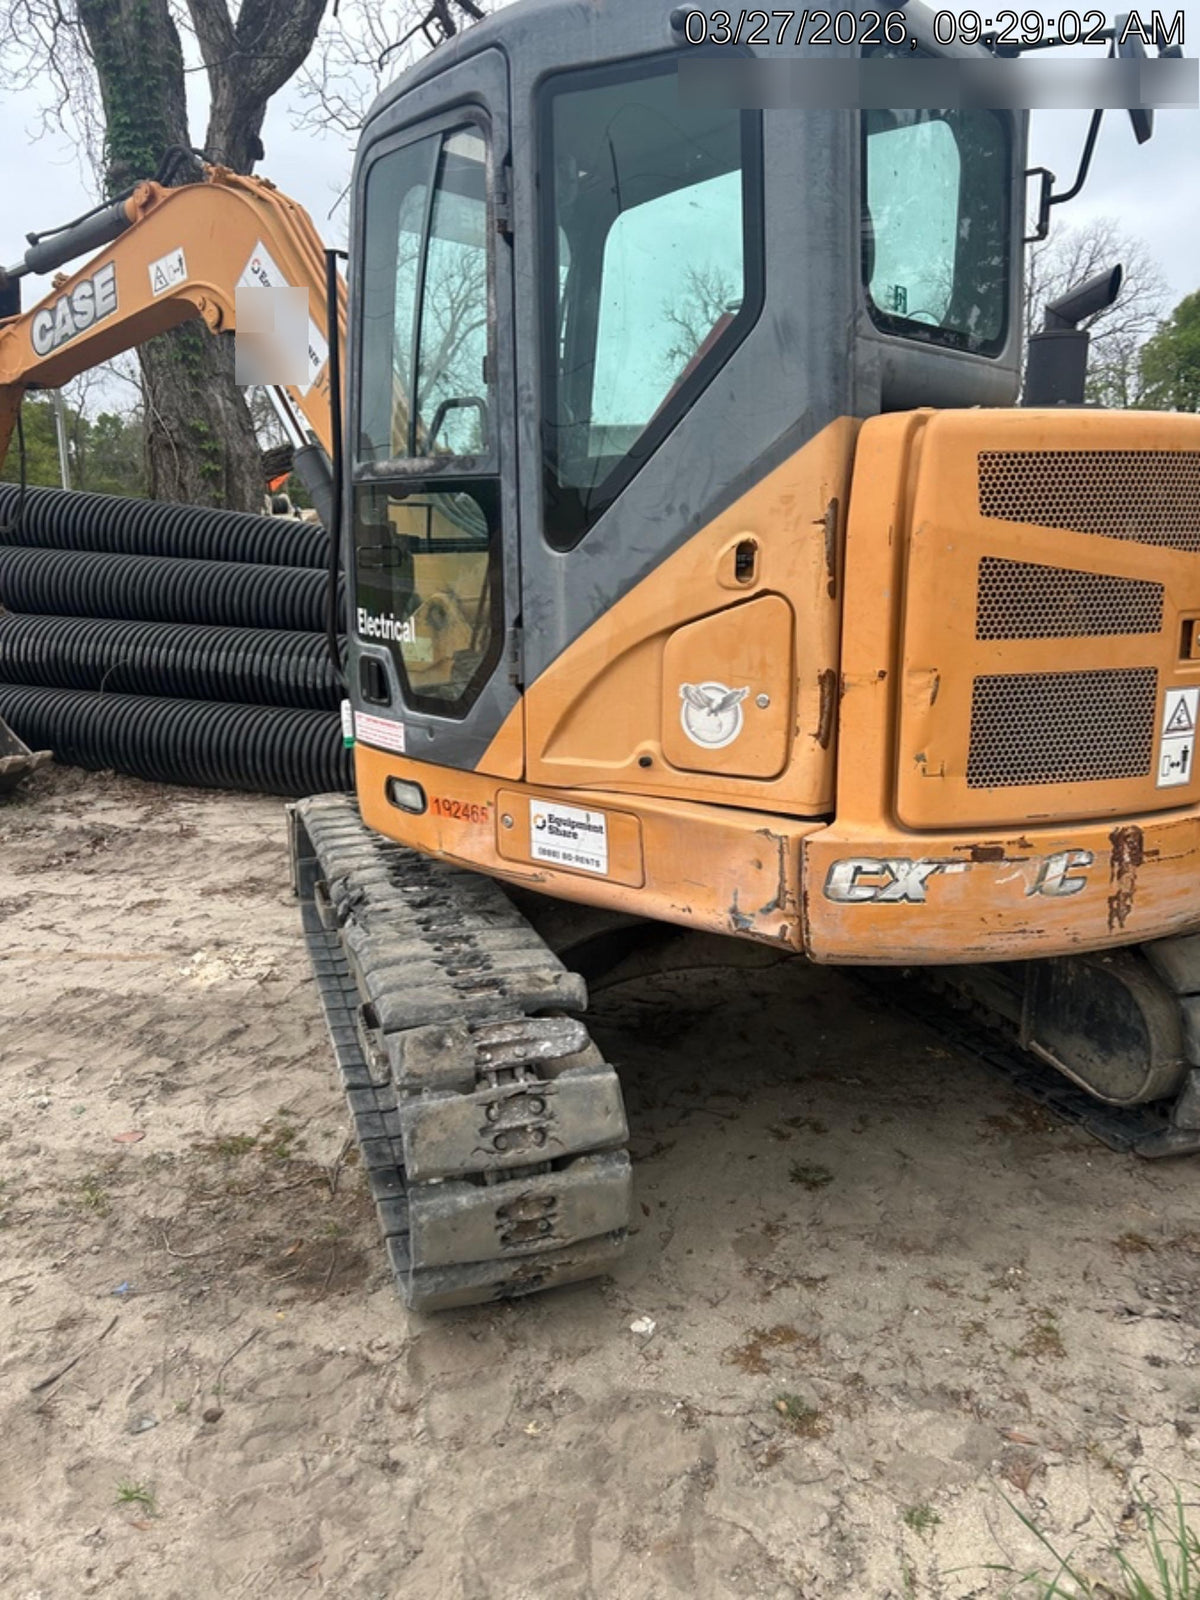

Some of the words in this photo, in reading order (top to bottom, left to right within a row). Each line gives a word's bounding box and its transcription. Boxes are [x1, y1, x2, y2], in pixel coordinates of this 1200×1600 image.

[30, 260, 118, 356] CASE
[357, 607, 415, 643] Electrical
[434, 798, 489, 824] 192465
[548, 813, 604, 834] Equipment
[548, 825, 578, 840] Share
